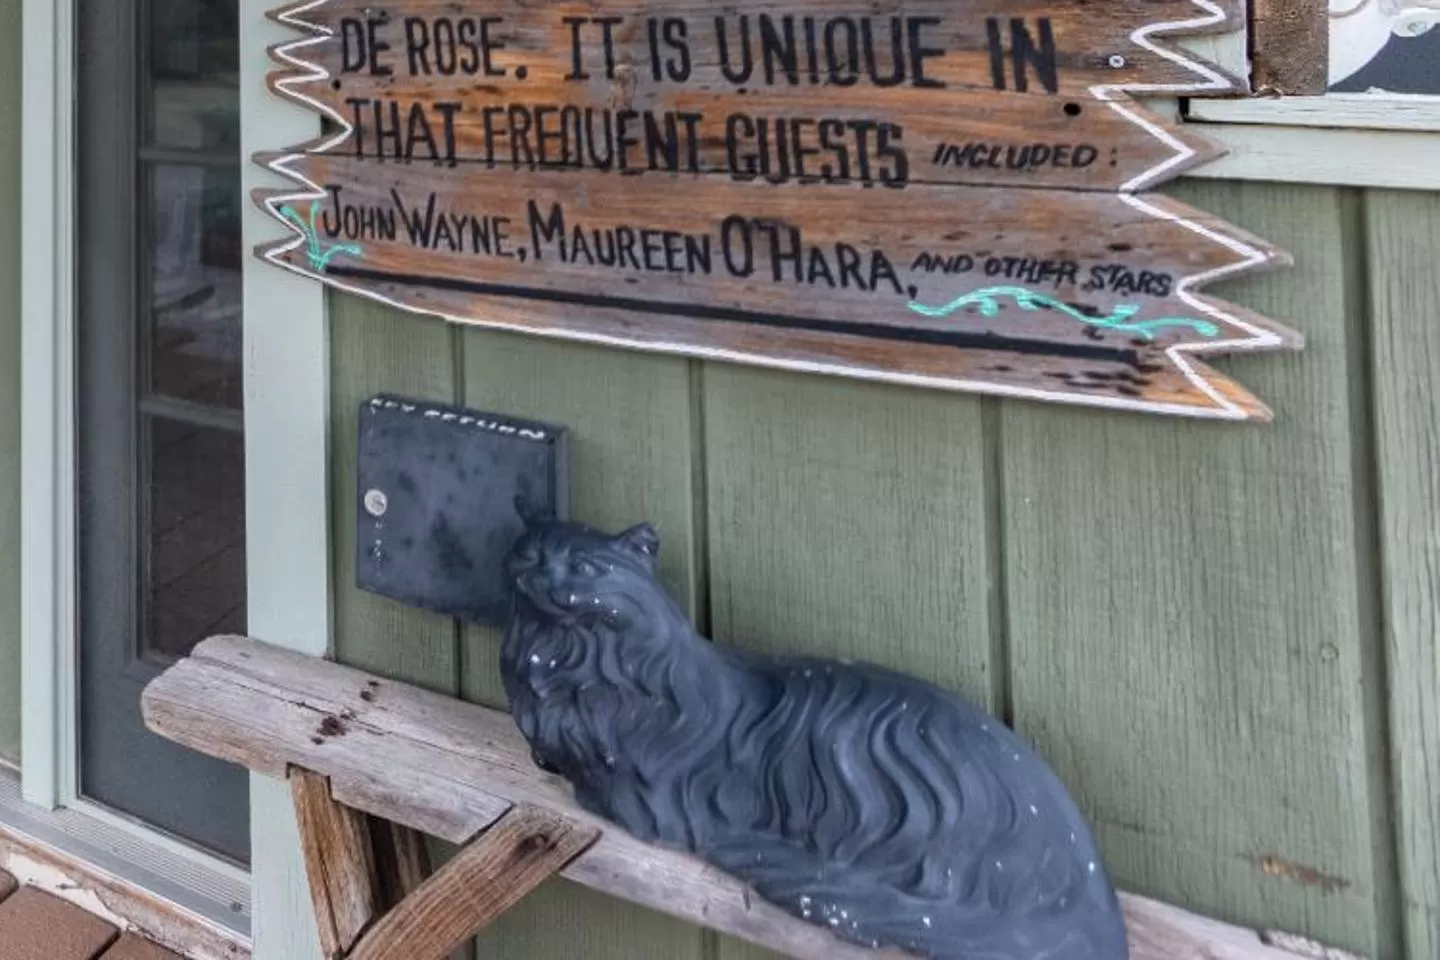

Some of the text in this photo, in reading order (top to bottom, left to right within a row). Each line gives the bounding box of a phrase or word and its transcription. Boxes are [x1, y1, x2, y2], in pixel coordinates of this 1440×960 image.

[340, 14, 1058, 93] DE ROSE. IT IS UNIQUE IN
[345, 97, 462, 168] THAT
[483, 103, 703, 177] FREQUENT
[725, 112, 909, 189] GUESTS
[911, 251, 974, 275] AND
[984, 256, 1080, 287] OTHER
[1086, 263, 1173, 298] STARS
